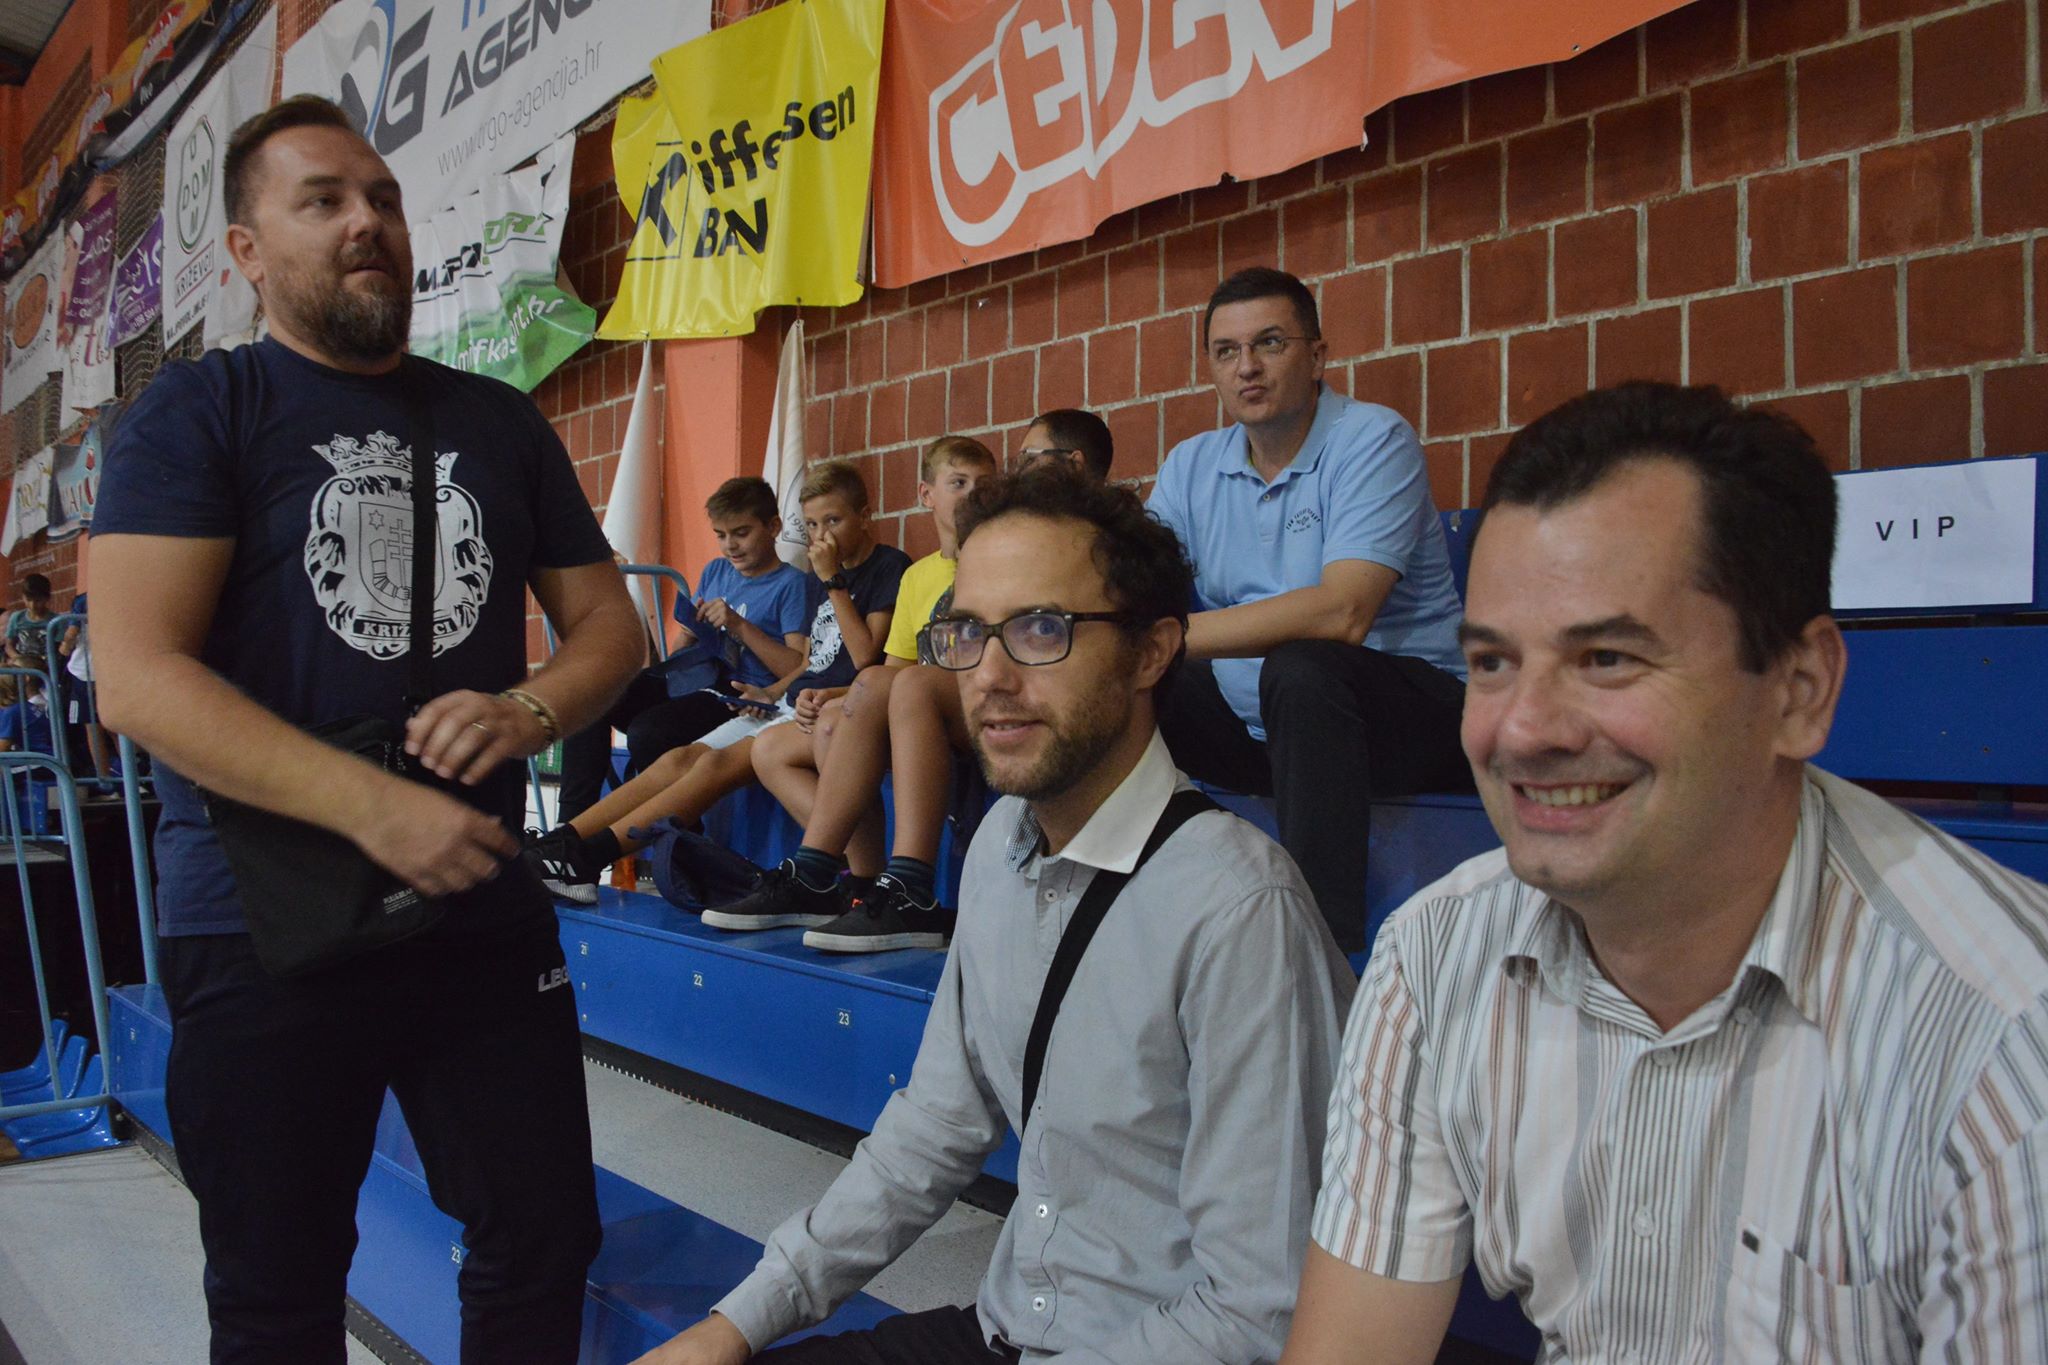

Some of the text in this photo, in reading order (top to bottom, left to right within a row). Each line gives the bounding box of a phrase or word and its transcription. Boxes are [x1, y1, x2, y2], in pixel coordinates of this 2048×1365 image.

[787, 512, 808, 540] 1996
[362, 618, 452, 638] KRIŽCI
[693, 974, 703, 987] 22
[838, 1011, 850, 1026] 23
[451, 1246, 461, 1264] 23
